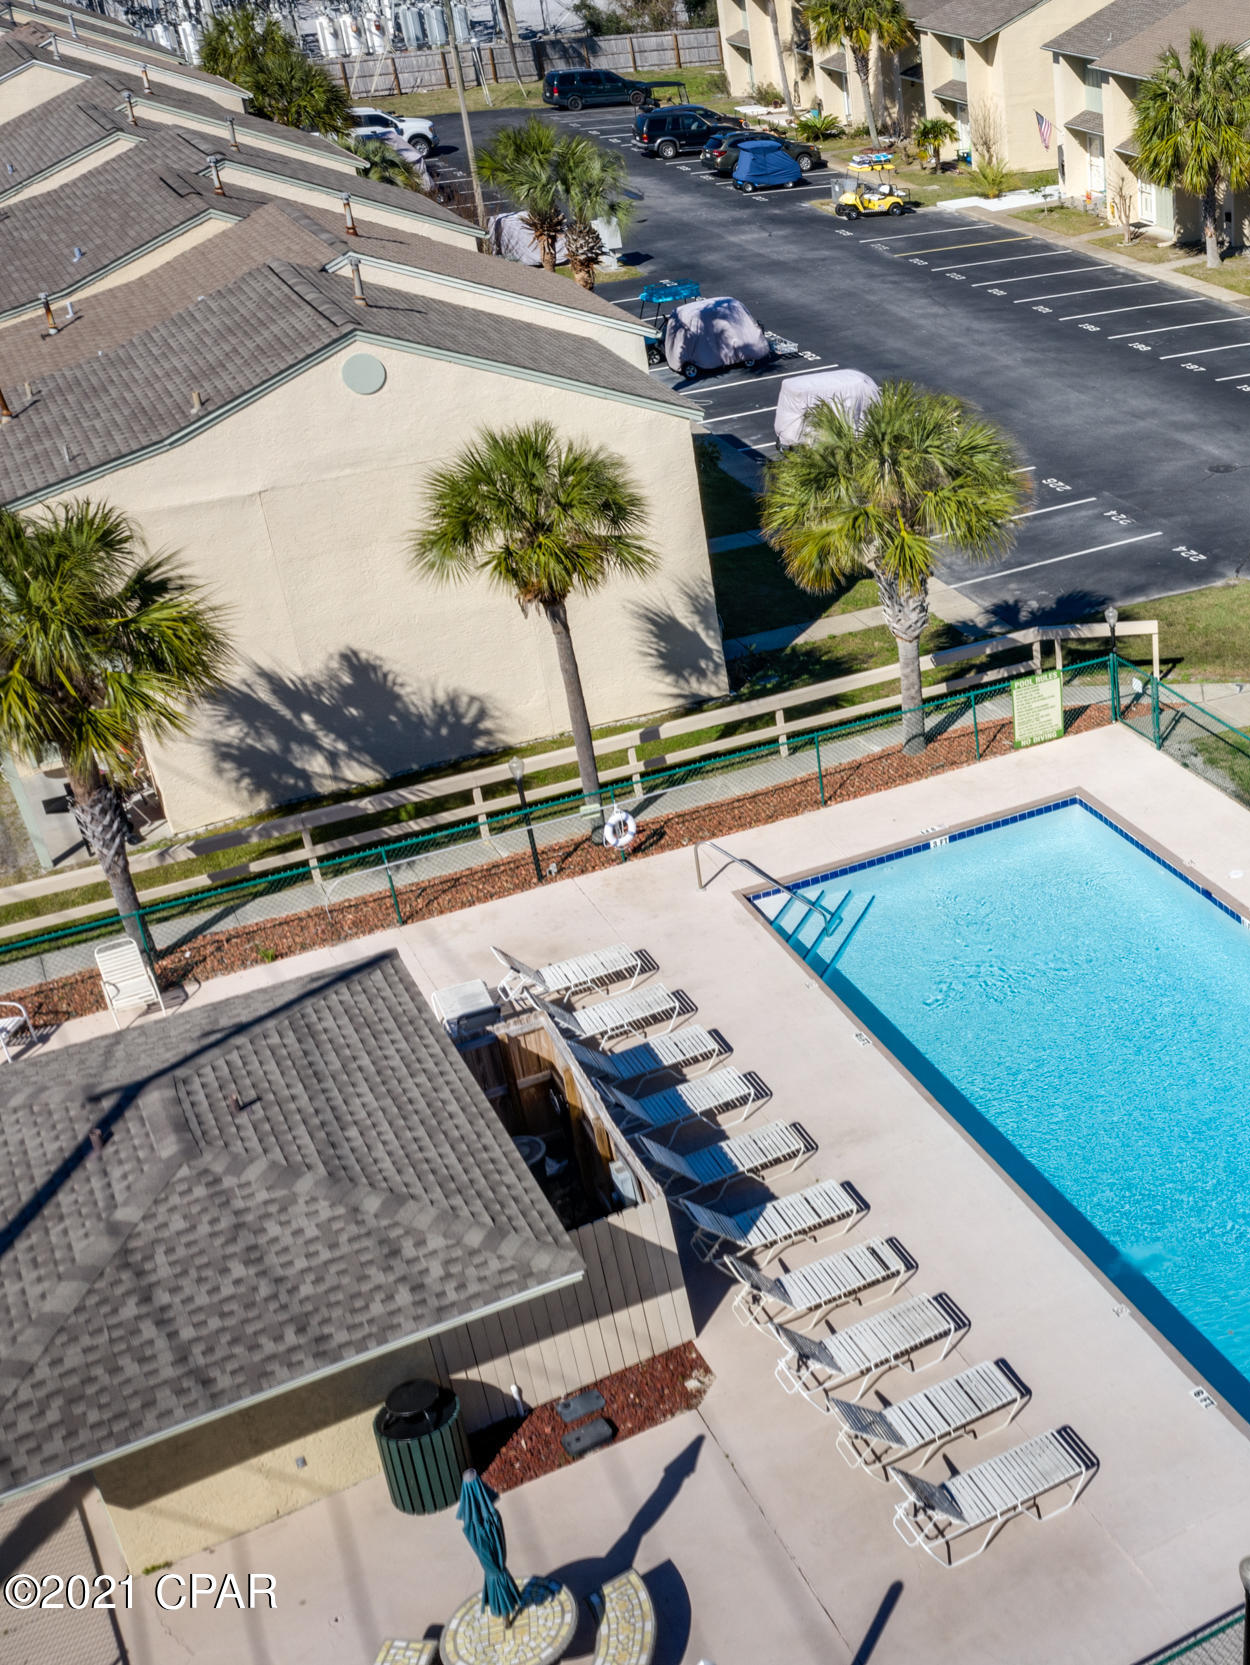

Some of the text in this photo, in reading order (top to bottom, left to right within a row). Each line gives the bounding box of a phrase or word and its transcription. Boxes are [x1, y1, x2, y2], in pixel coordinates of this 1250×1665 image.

[1180, 362, 1208, 373] 197
[1041, 477, 1073, 493] 226
[1103, 509, 1137, 526] 224
[1171, 545, 1208, 562] 224
[1014, 671, 1058, 689] POOL RULES
[1021, 730, 1057, 748] NO DIVING
[939, 837, 948, 848] FT
[1200, 1396, 1216, 1409] FT
